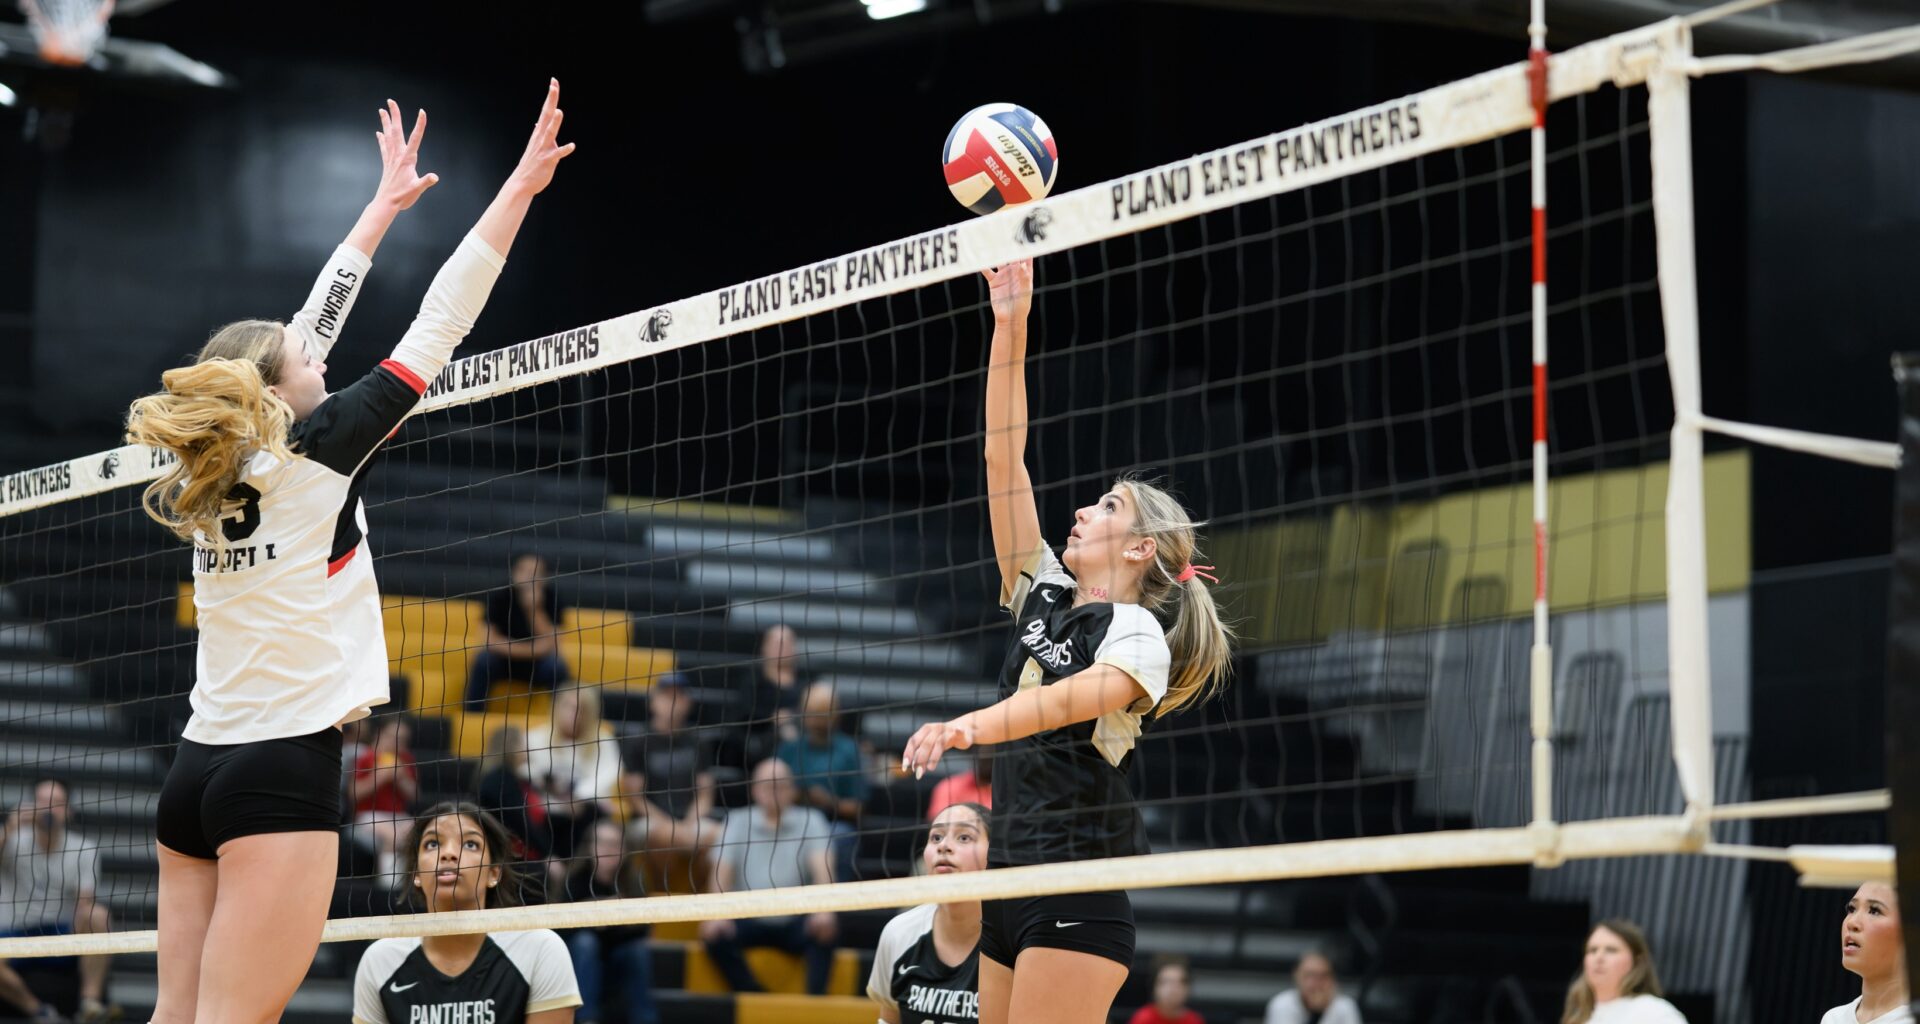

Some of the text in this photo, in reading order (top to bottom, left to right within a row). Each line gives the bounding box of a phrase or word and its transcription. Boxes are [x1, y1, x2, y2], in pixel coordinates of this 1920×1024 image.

[997, 134, 1035, 177] Baden
[1112, 102, 1421, 220] PLANO EAST PANTHERS
[314, 268, 357, 339] COWGIRLS
[718, 229, 960, 325] PLANO EAST PANTHERS
[423, 325, 600, 399] ANO EAST PANTHERS
[9, 463, 71, 501] PANTHERS
[151, 446, 179, 469] PLA
[410, 998, 496, 1024] PANTHERS
[907, 984, 979, 1018] PANTHERS
